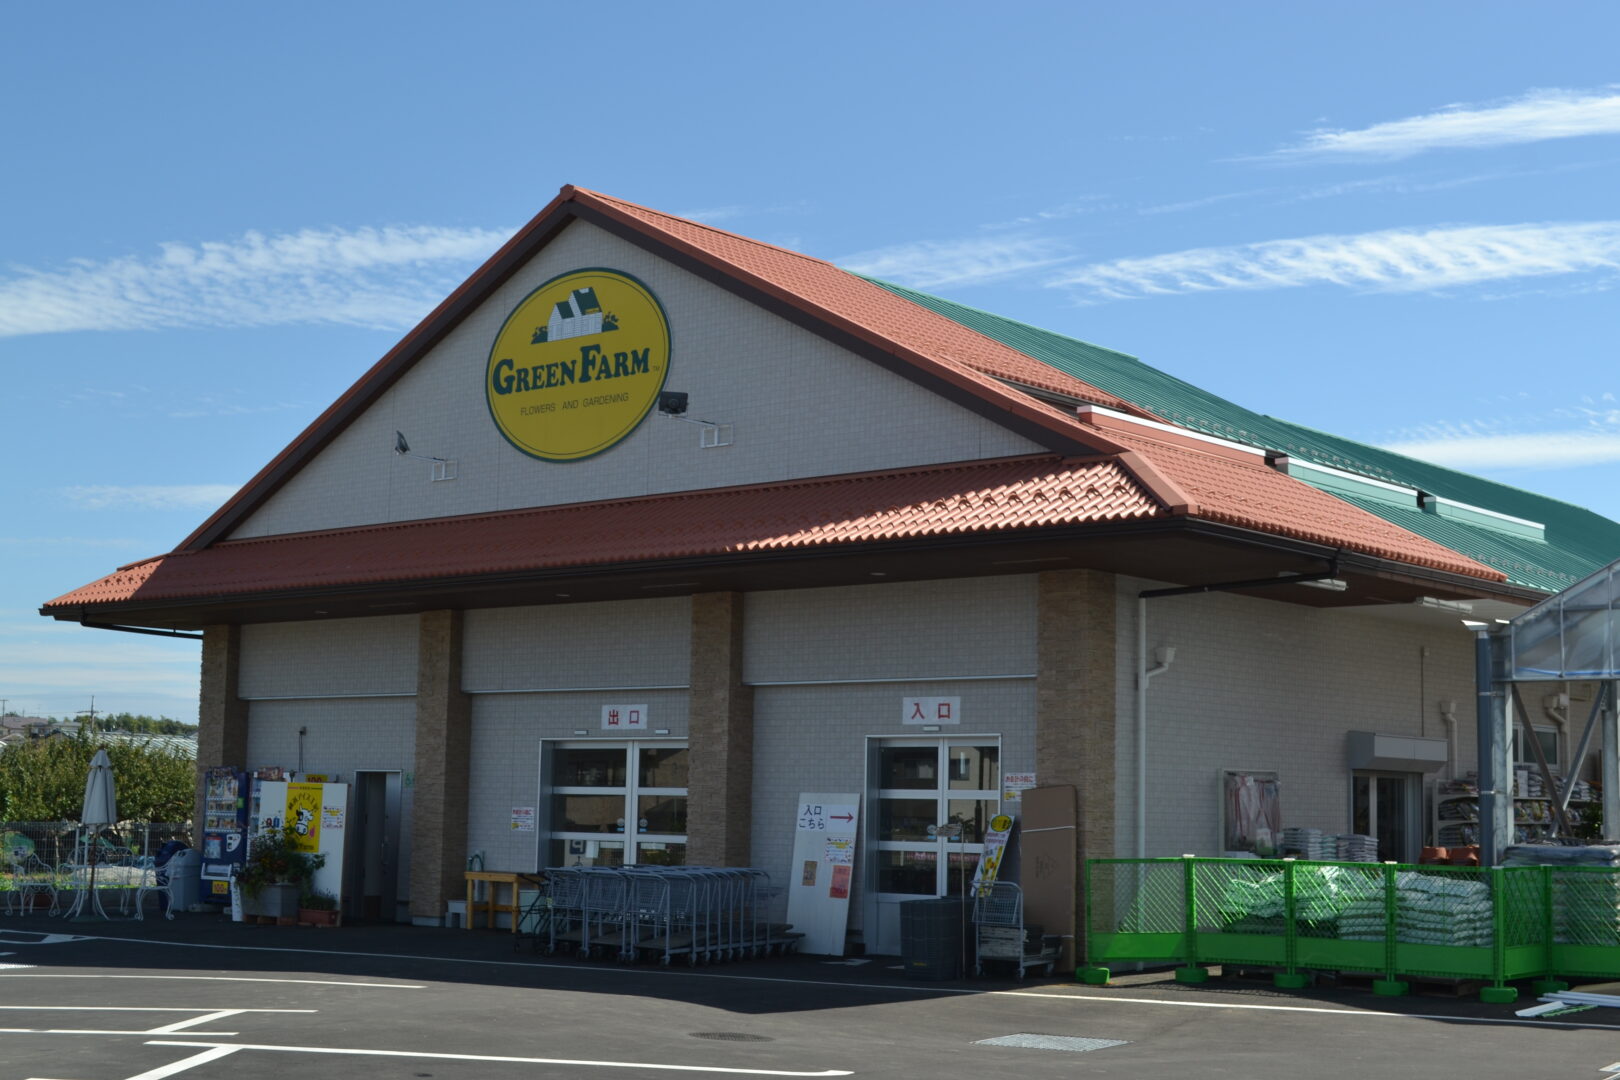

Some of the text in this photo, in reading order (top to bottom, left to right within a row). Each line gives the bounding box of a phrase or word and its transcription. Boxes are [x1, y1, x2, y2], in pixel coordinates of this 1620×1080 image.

[520, 392, 629, 416] FLOWERS AND GARDENING
[608, 709, 640, 726] 出口
[911, 702, 951, 720] 入口
[804, 804, 822, 816] 入口
[799, 818, 825, 829] こちら
